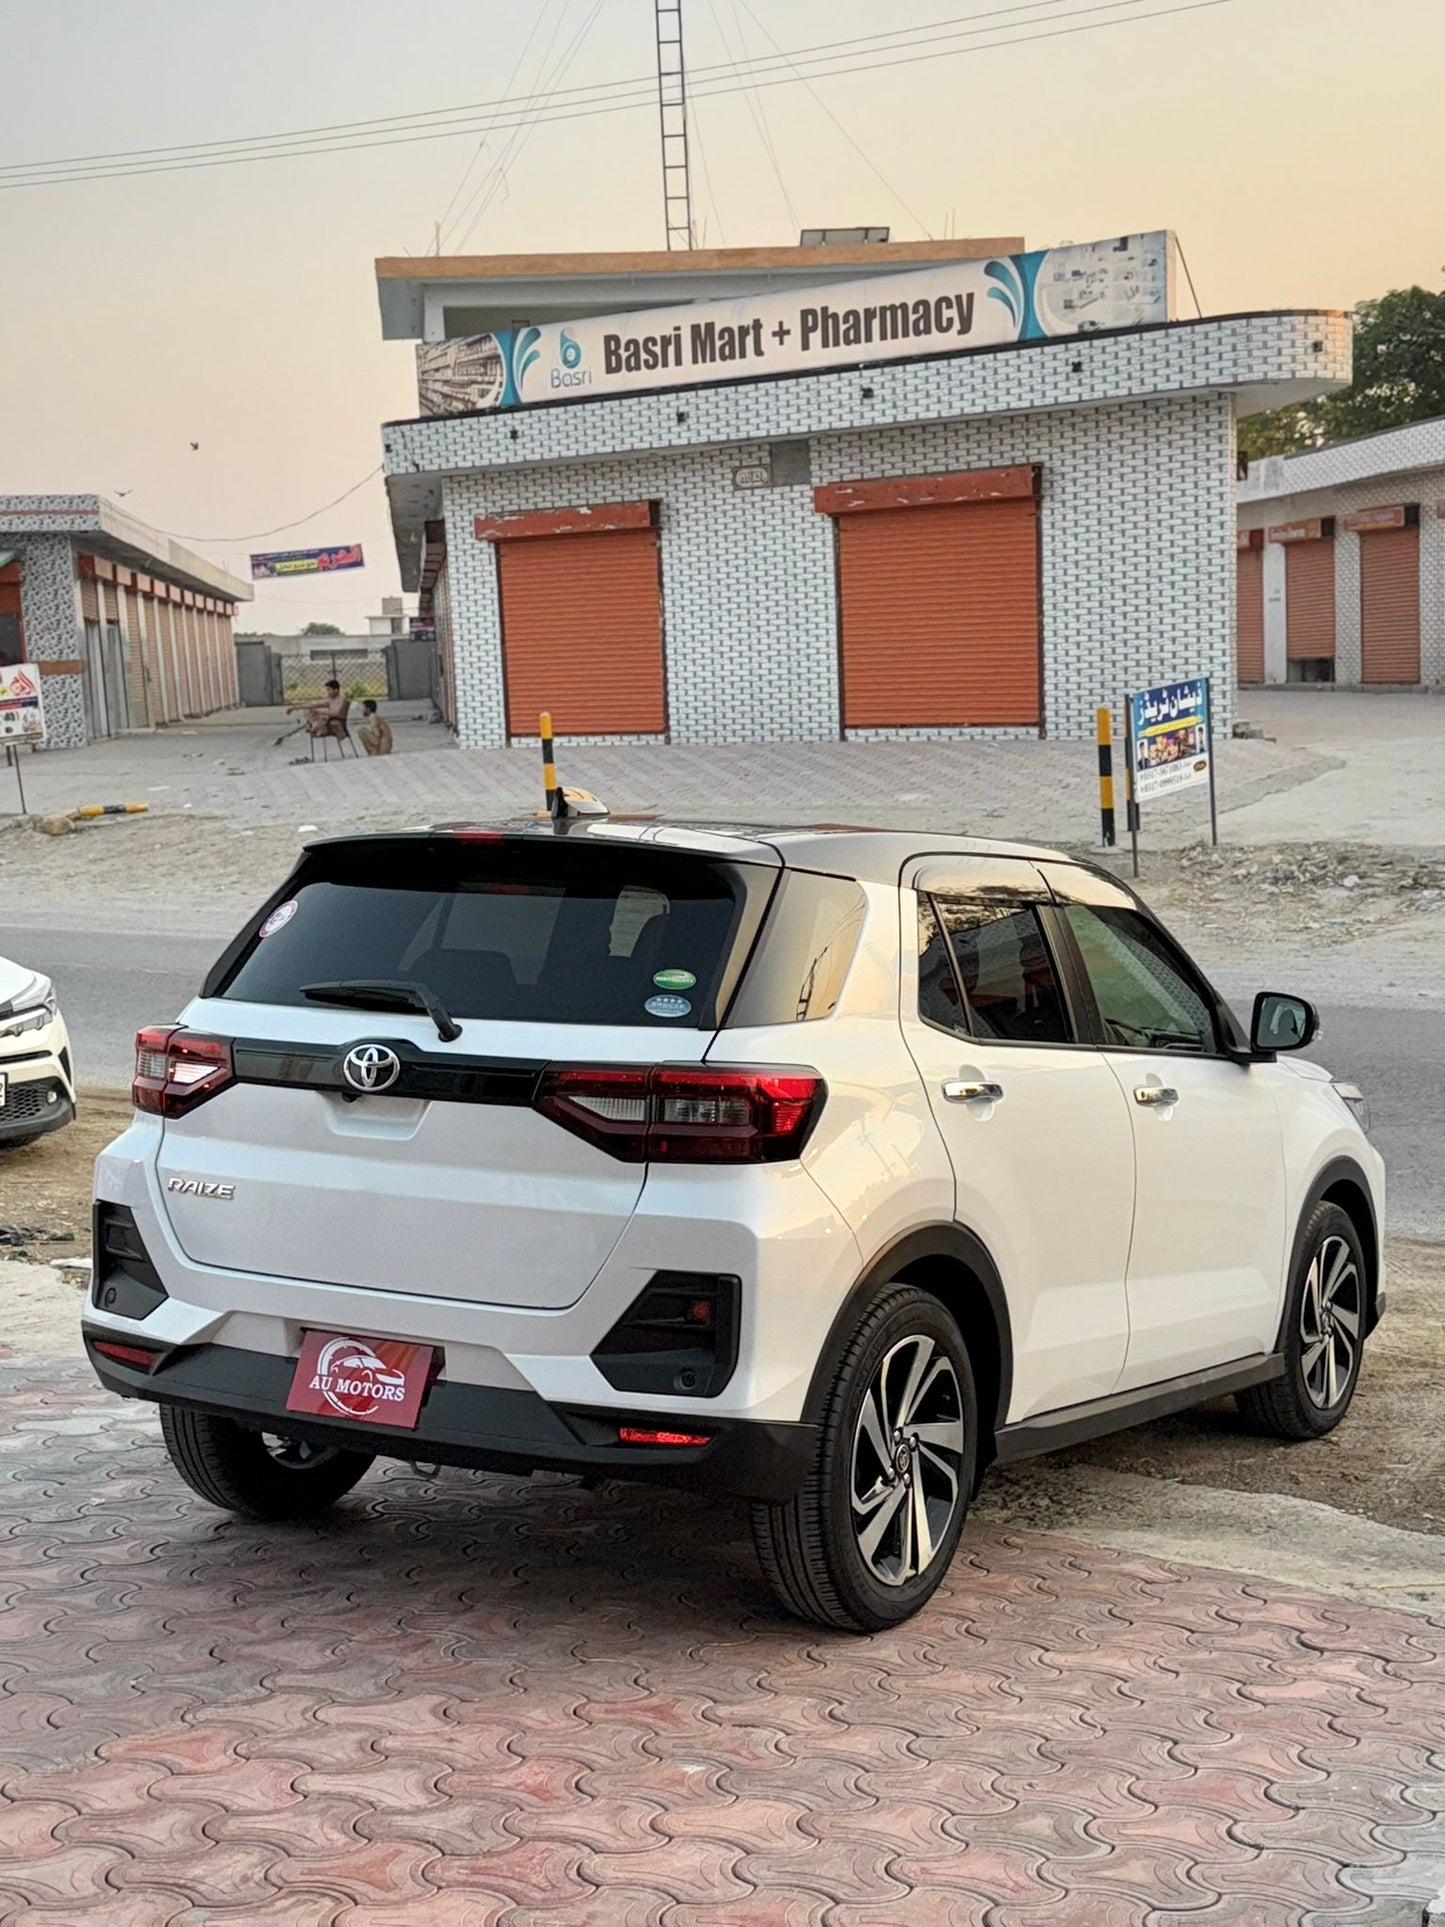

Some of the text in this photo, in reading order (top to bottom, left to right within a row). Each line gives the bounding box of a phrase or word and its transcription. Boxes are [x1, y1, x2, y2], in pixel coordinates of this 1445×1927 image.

[603, 325, 683, 375] Basri
[690, 318, 765, 365] Mart
[800, 291, 975, 352] Pharmacy
[551, 366, 592, 388] Basri
[168, 1178, 235, 1200] RAIZE
[309, 1375, 406, 1401] AU MOTORS
